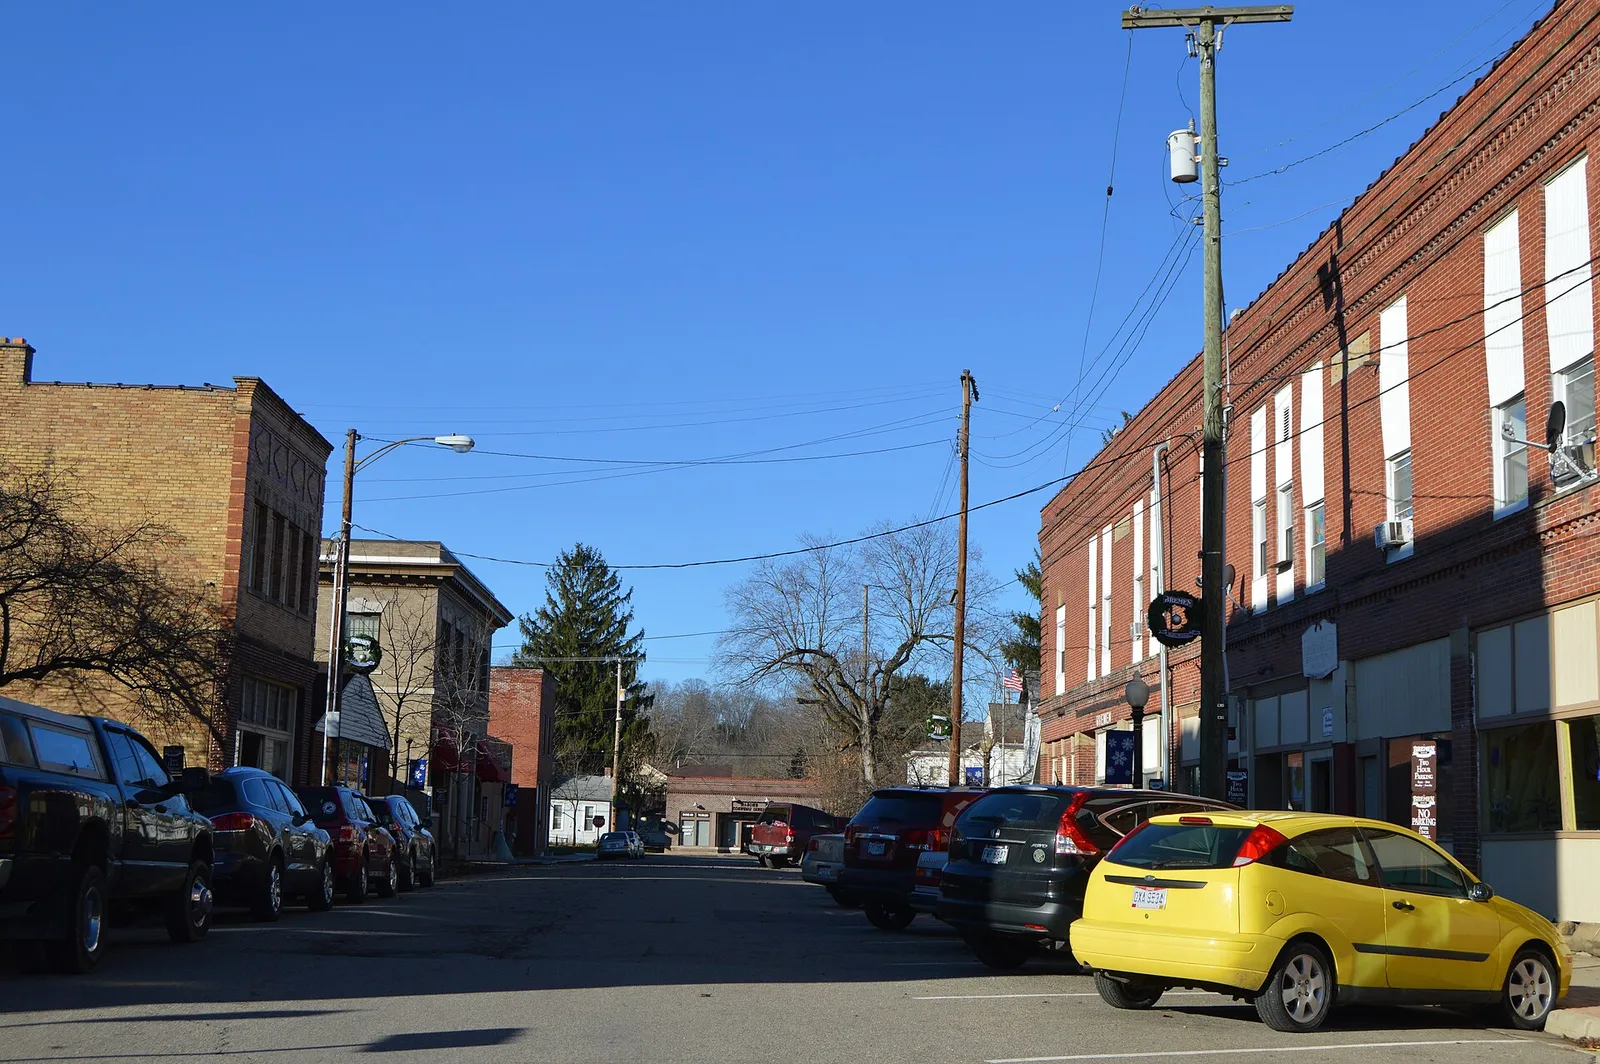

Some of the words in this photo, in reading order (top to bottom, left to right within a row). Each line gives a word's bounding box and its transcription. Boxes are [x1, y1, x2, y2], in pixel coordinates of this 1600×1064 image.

[1164, 595, 1192, 607] BREMEN
[1413, 745, 1436, 754] BREMEN
[1416, 765, 1431, 773] HOUR
[1414, 772, 1434, 780] PARKING
[1412, 795, 1435, 804] BREMEN
[1417, 809, 1431, 818] NO
[1411, 817, 1436, 826] PARKING
